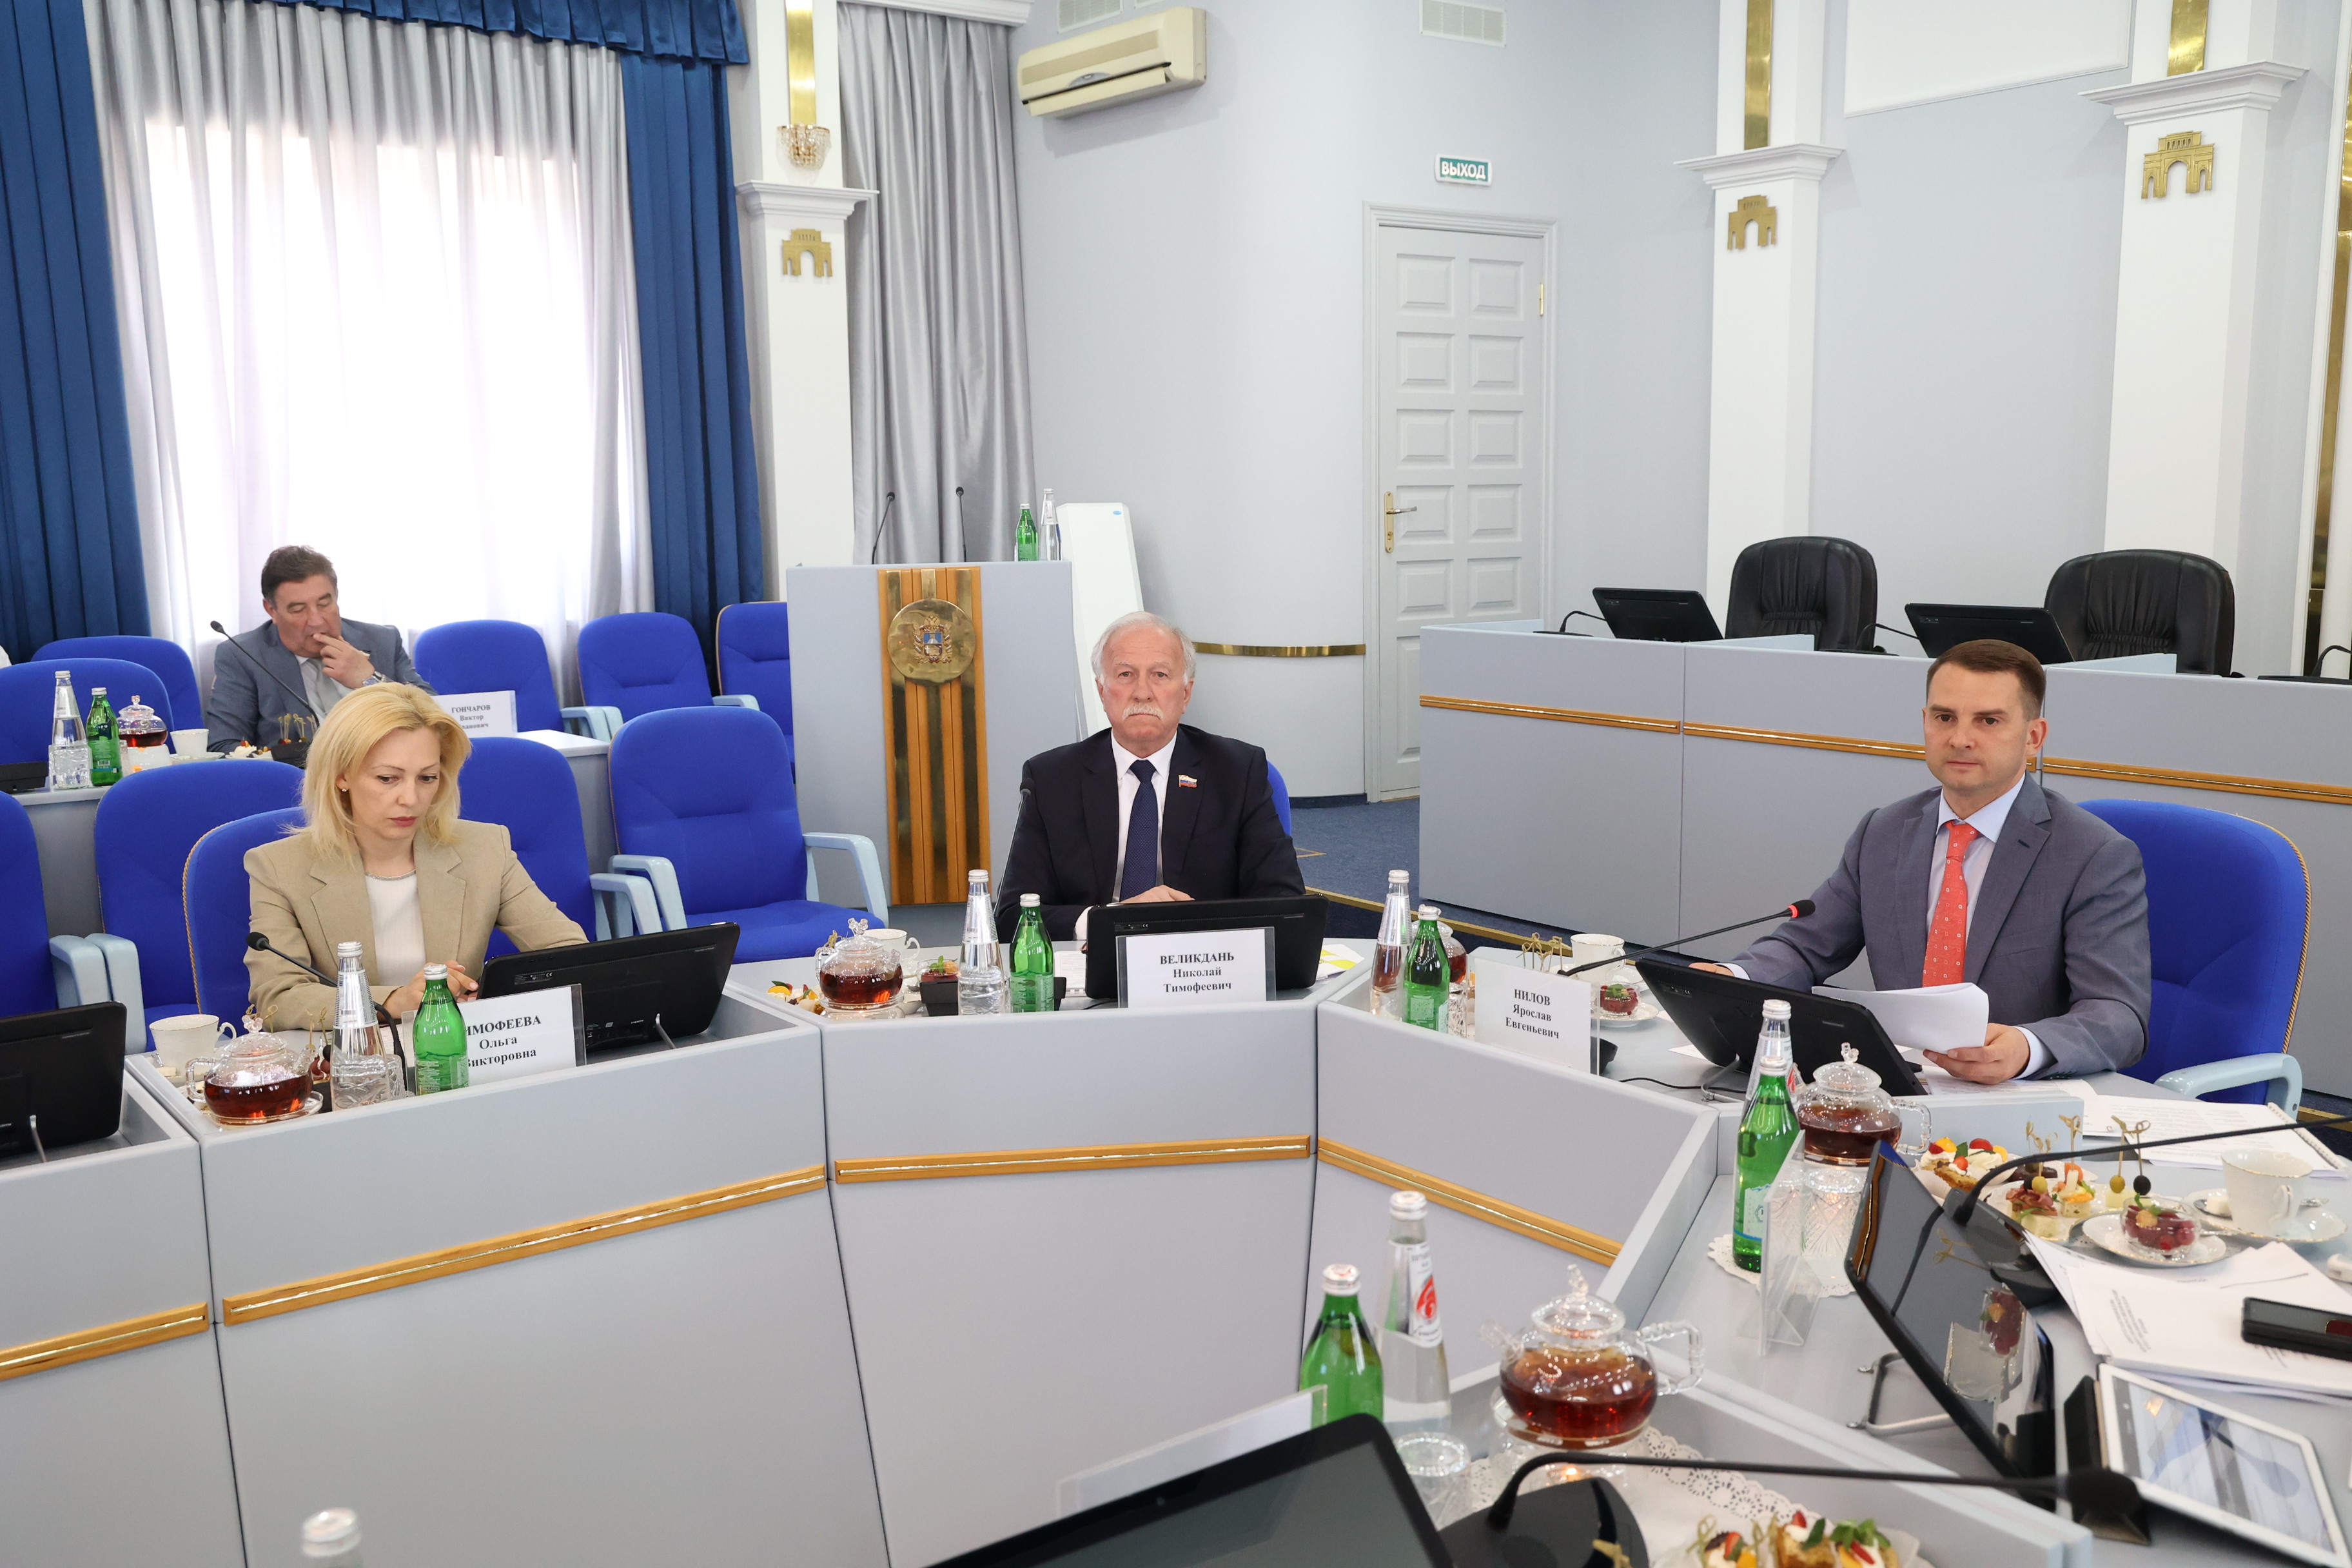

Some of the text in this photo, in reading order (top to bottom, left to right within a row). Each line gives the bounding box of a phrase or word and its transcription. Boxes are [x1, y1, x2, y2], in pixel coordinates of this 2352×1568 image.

[1442, 161, 1486, 180] ВЫХОД
[451, 704, 491, 713] ГОНЧАРОВ
[1160, 952, 1235, 965] ВЕЛИКДАНЬ
[1173, 966, 1222, 978] Николай
[1163, 982, 1232, 994] Тимофеевич
[1514, 988, 1551, 1006] НИЛОВ
[1513, 1004, 1552, 1022] Ярослав
[466, 1015, 542, 1036] ИМОФЕЕВА
[1505, 1017, 1560, 1039] Евгеньевич
[479, 1036, 518, 1050] Ольга
